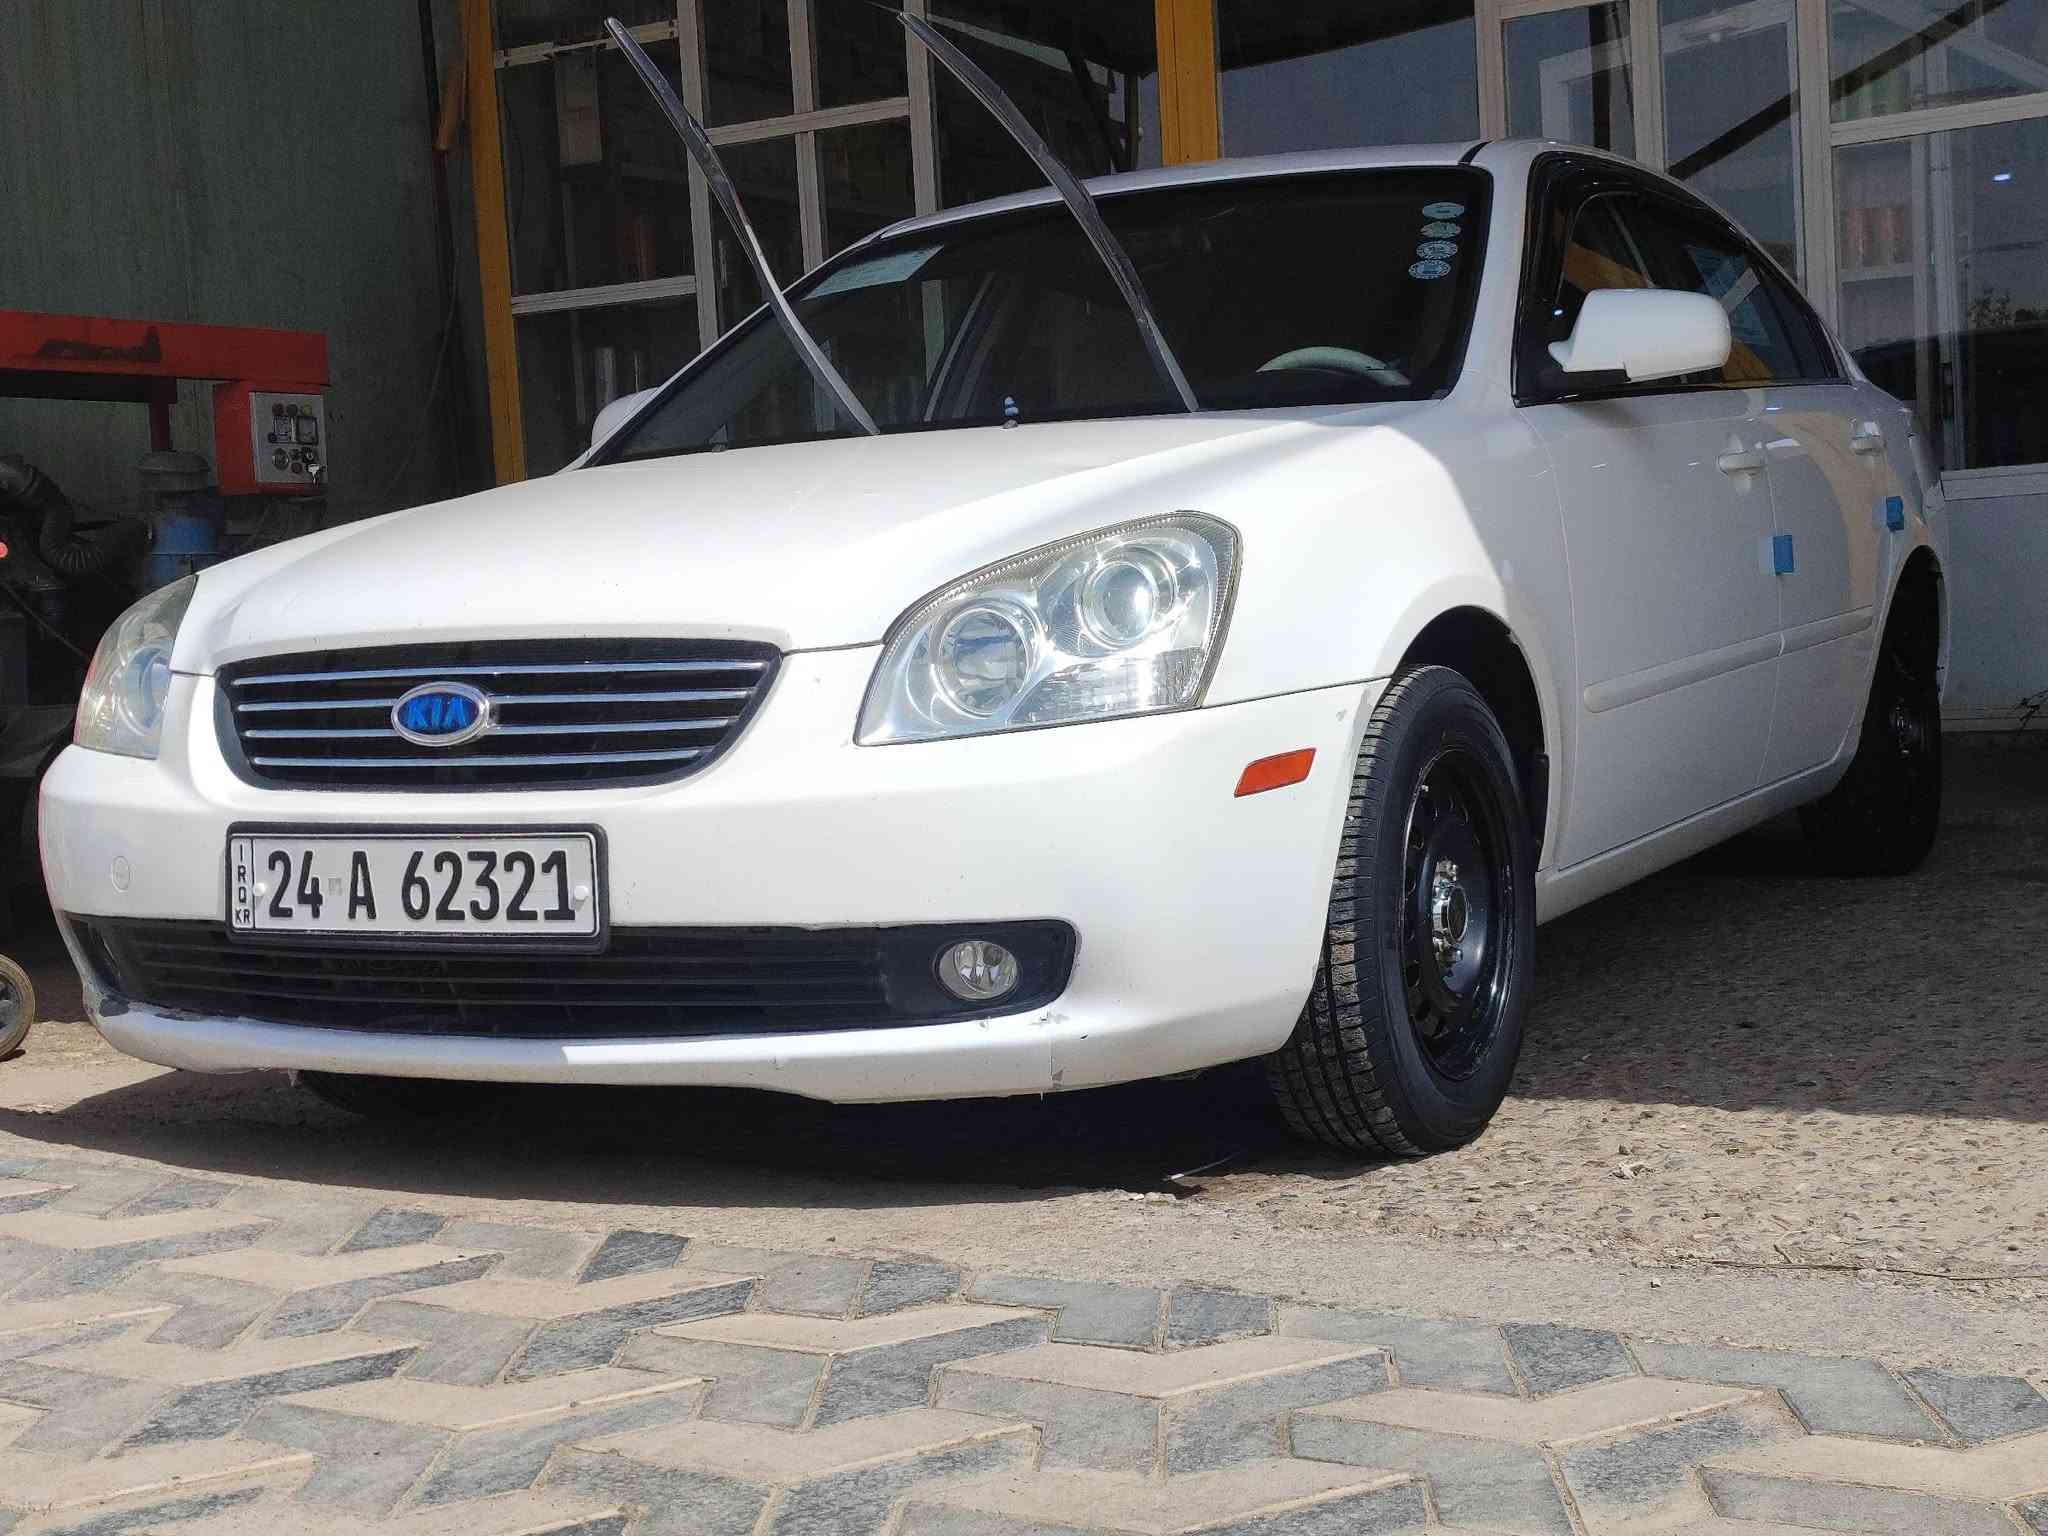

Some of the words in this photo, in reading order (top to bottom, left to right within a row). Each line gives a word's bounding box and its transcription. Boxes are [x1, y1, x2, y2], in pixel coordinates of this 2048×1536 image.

[406, 695, 467, 731] KIA
[268, 850, 323, 919] 24
[347, 850, 377, 920] A
[402, 850, 576, 921] 62321
